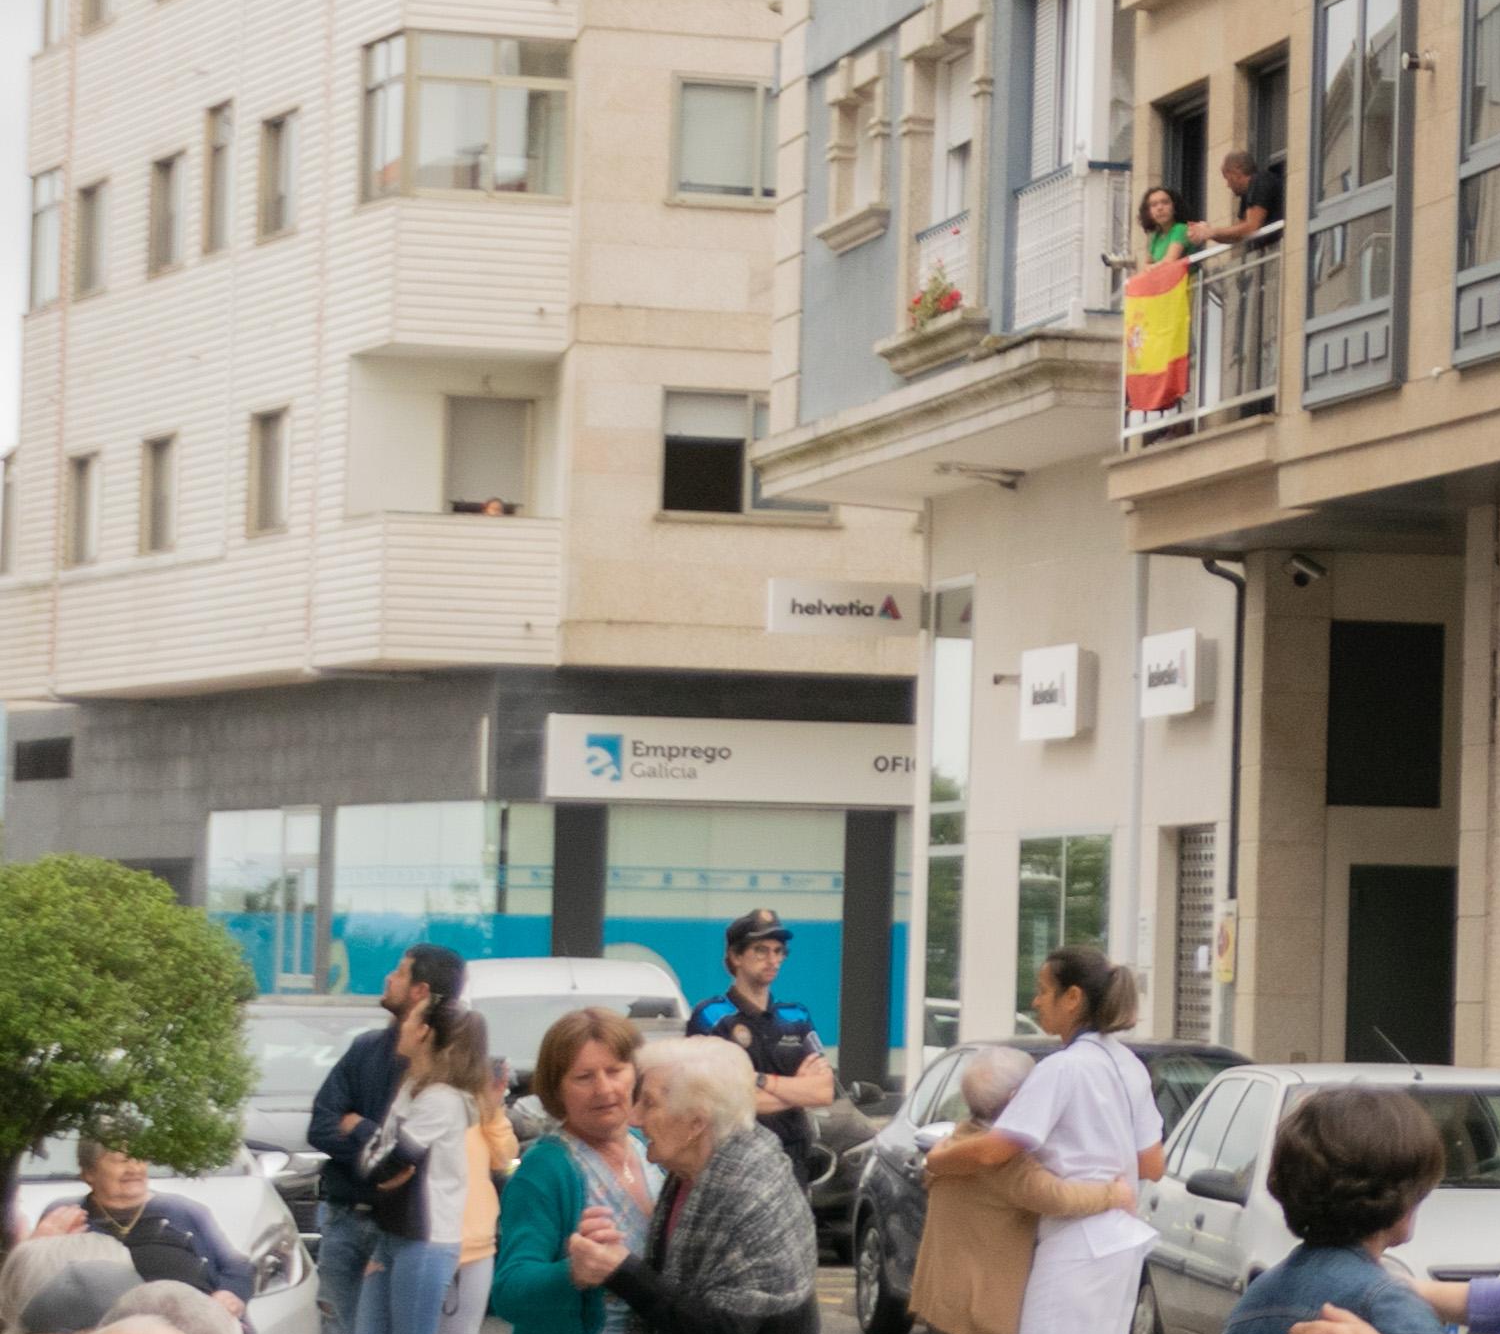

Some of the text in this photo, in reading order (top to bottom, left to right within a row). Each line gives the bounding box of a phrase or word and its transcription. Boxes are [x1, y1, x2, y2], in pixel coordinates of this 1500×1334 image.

[790, 598, 875, 617] helvetia
[631, 739, 732, 764] Emprego
[630, 761, 698, 780] Galicia
